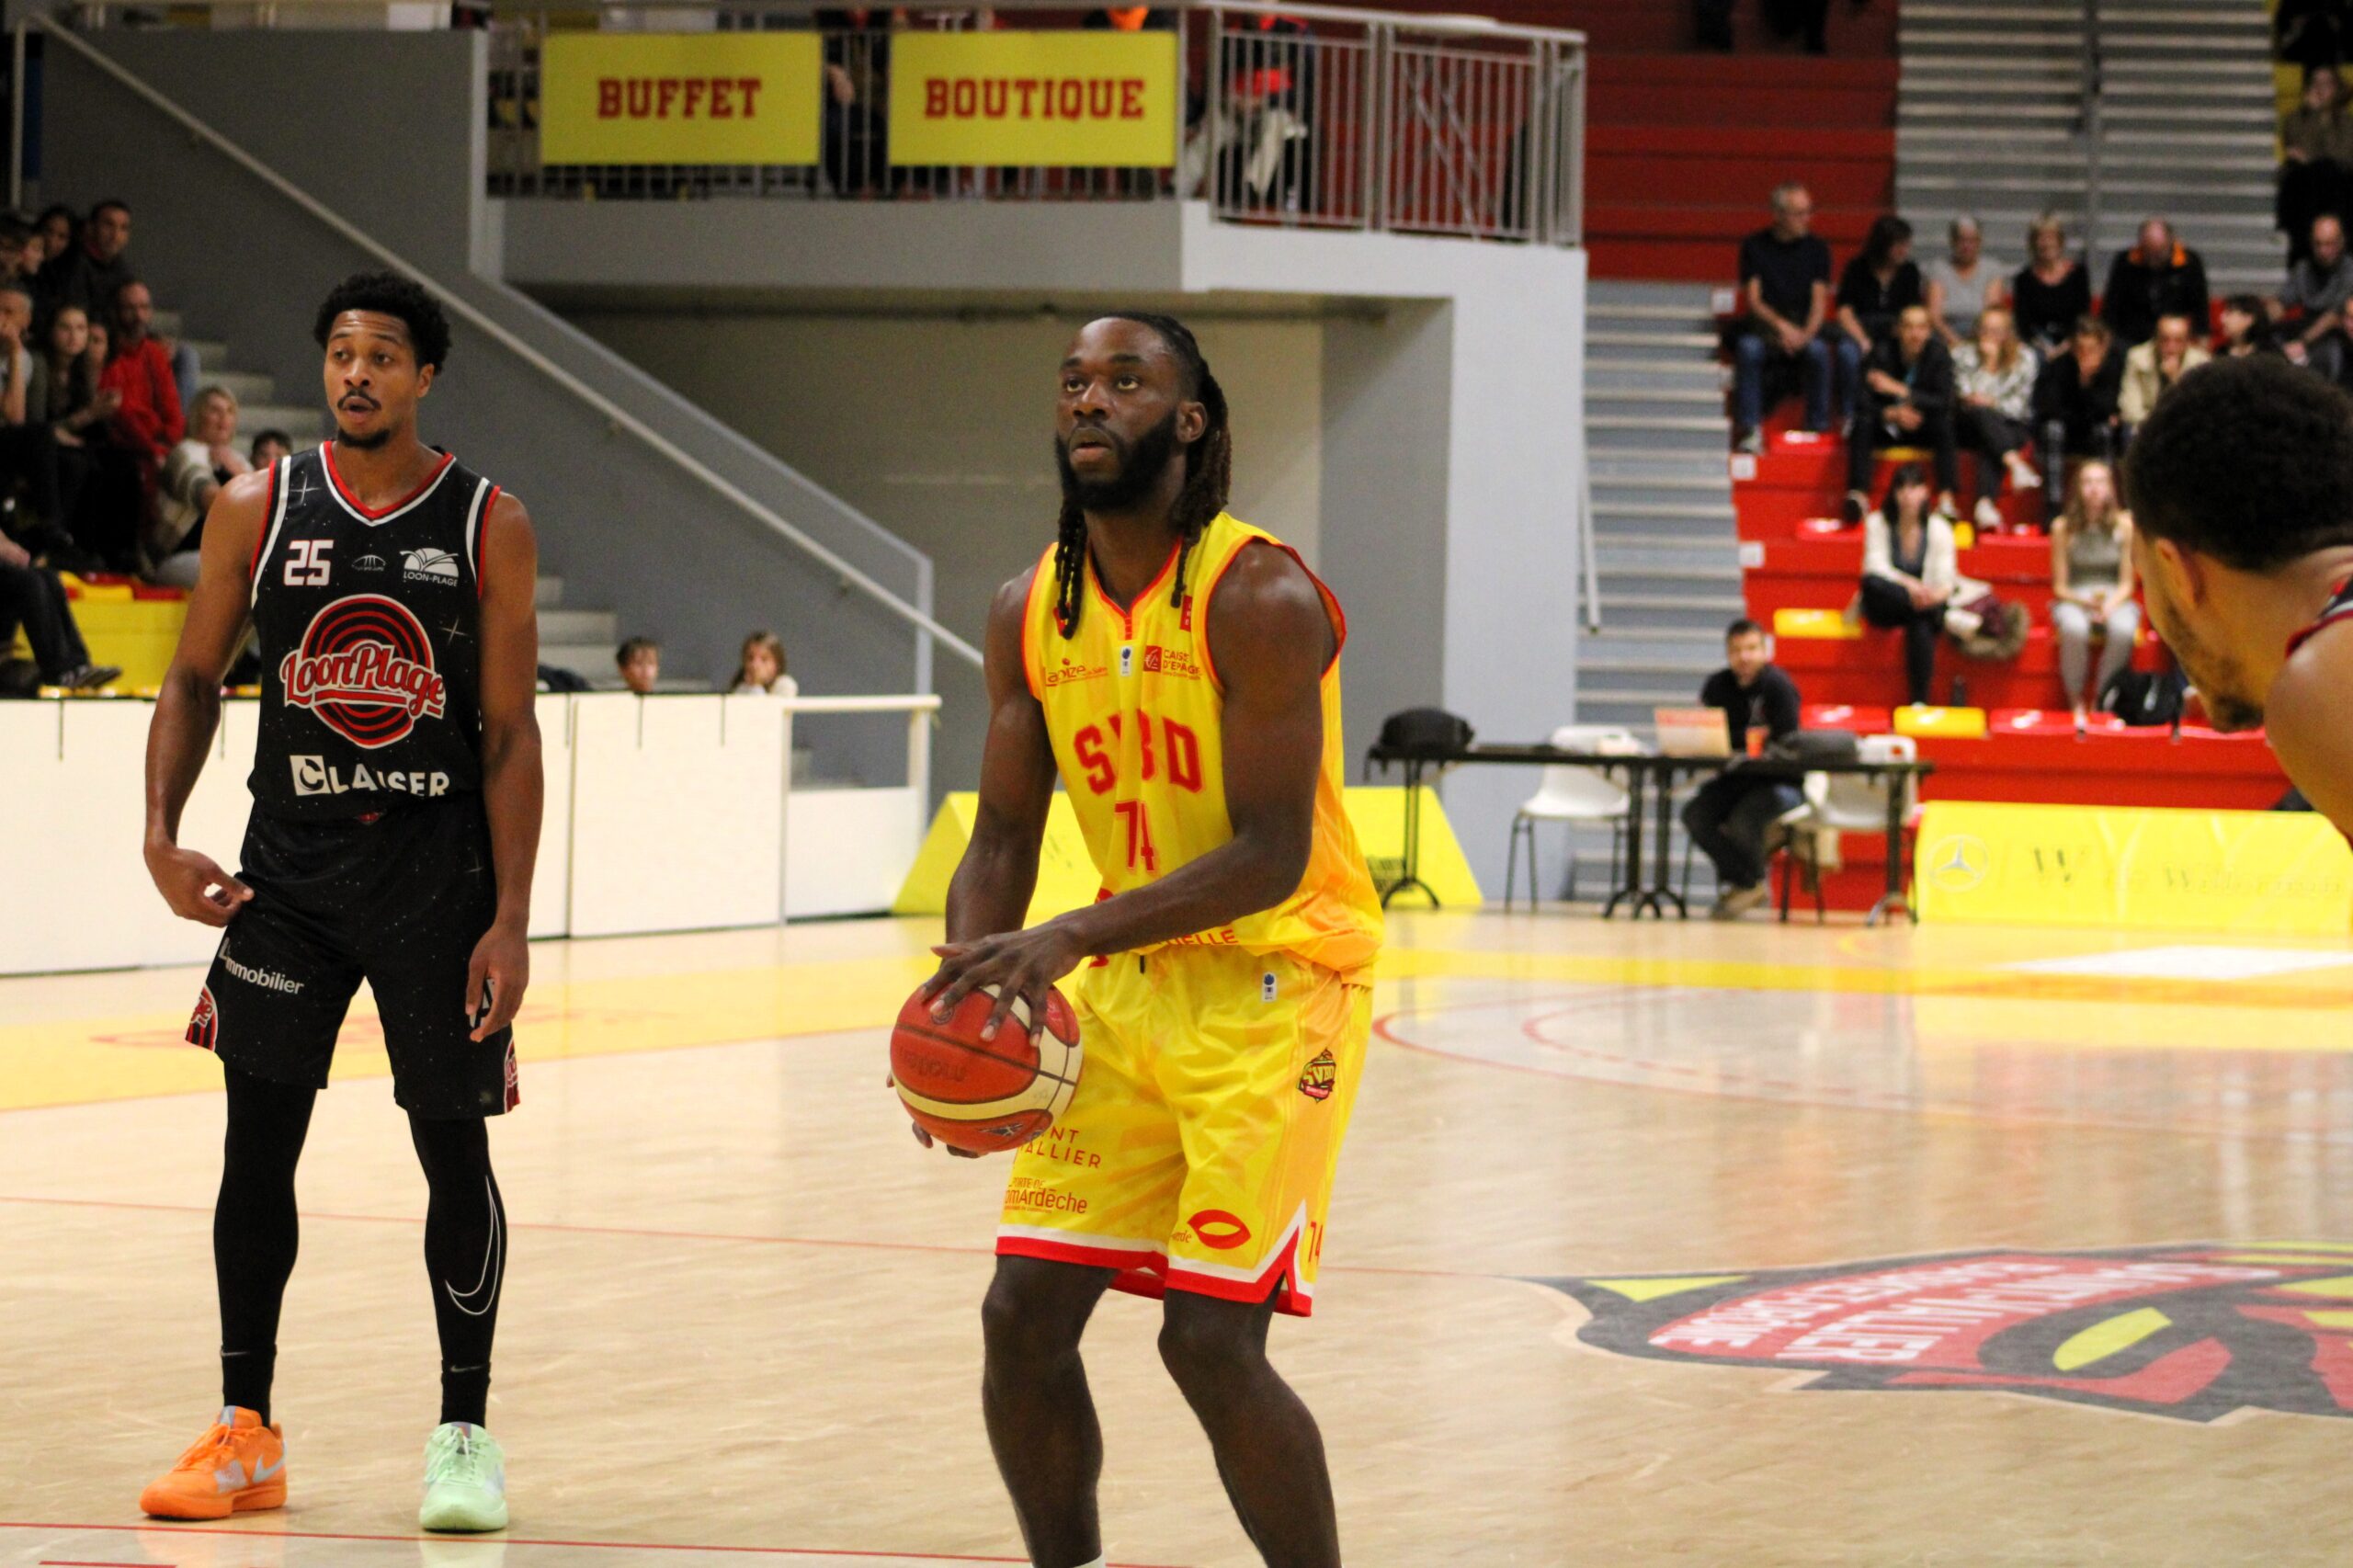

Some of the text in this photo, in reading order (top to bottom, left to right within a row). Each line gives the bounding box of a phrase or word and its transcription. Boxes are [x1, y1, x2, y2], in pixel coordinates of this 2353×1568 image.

[597, 78, 762, 119] BUFFET
[925, 78, 1145, 120] BOUTIQUE
[283, 540, 334, 586] 25
[404, 571, 459, 587] LOON-PLAGE
[1114, 800, 1155, 871] 74
[1020, 1140, 1102, 1169] ALLIER
